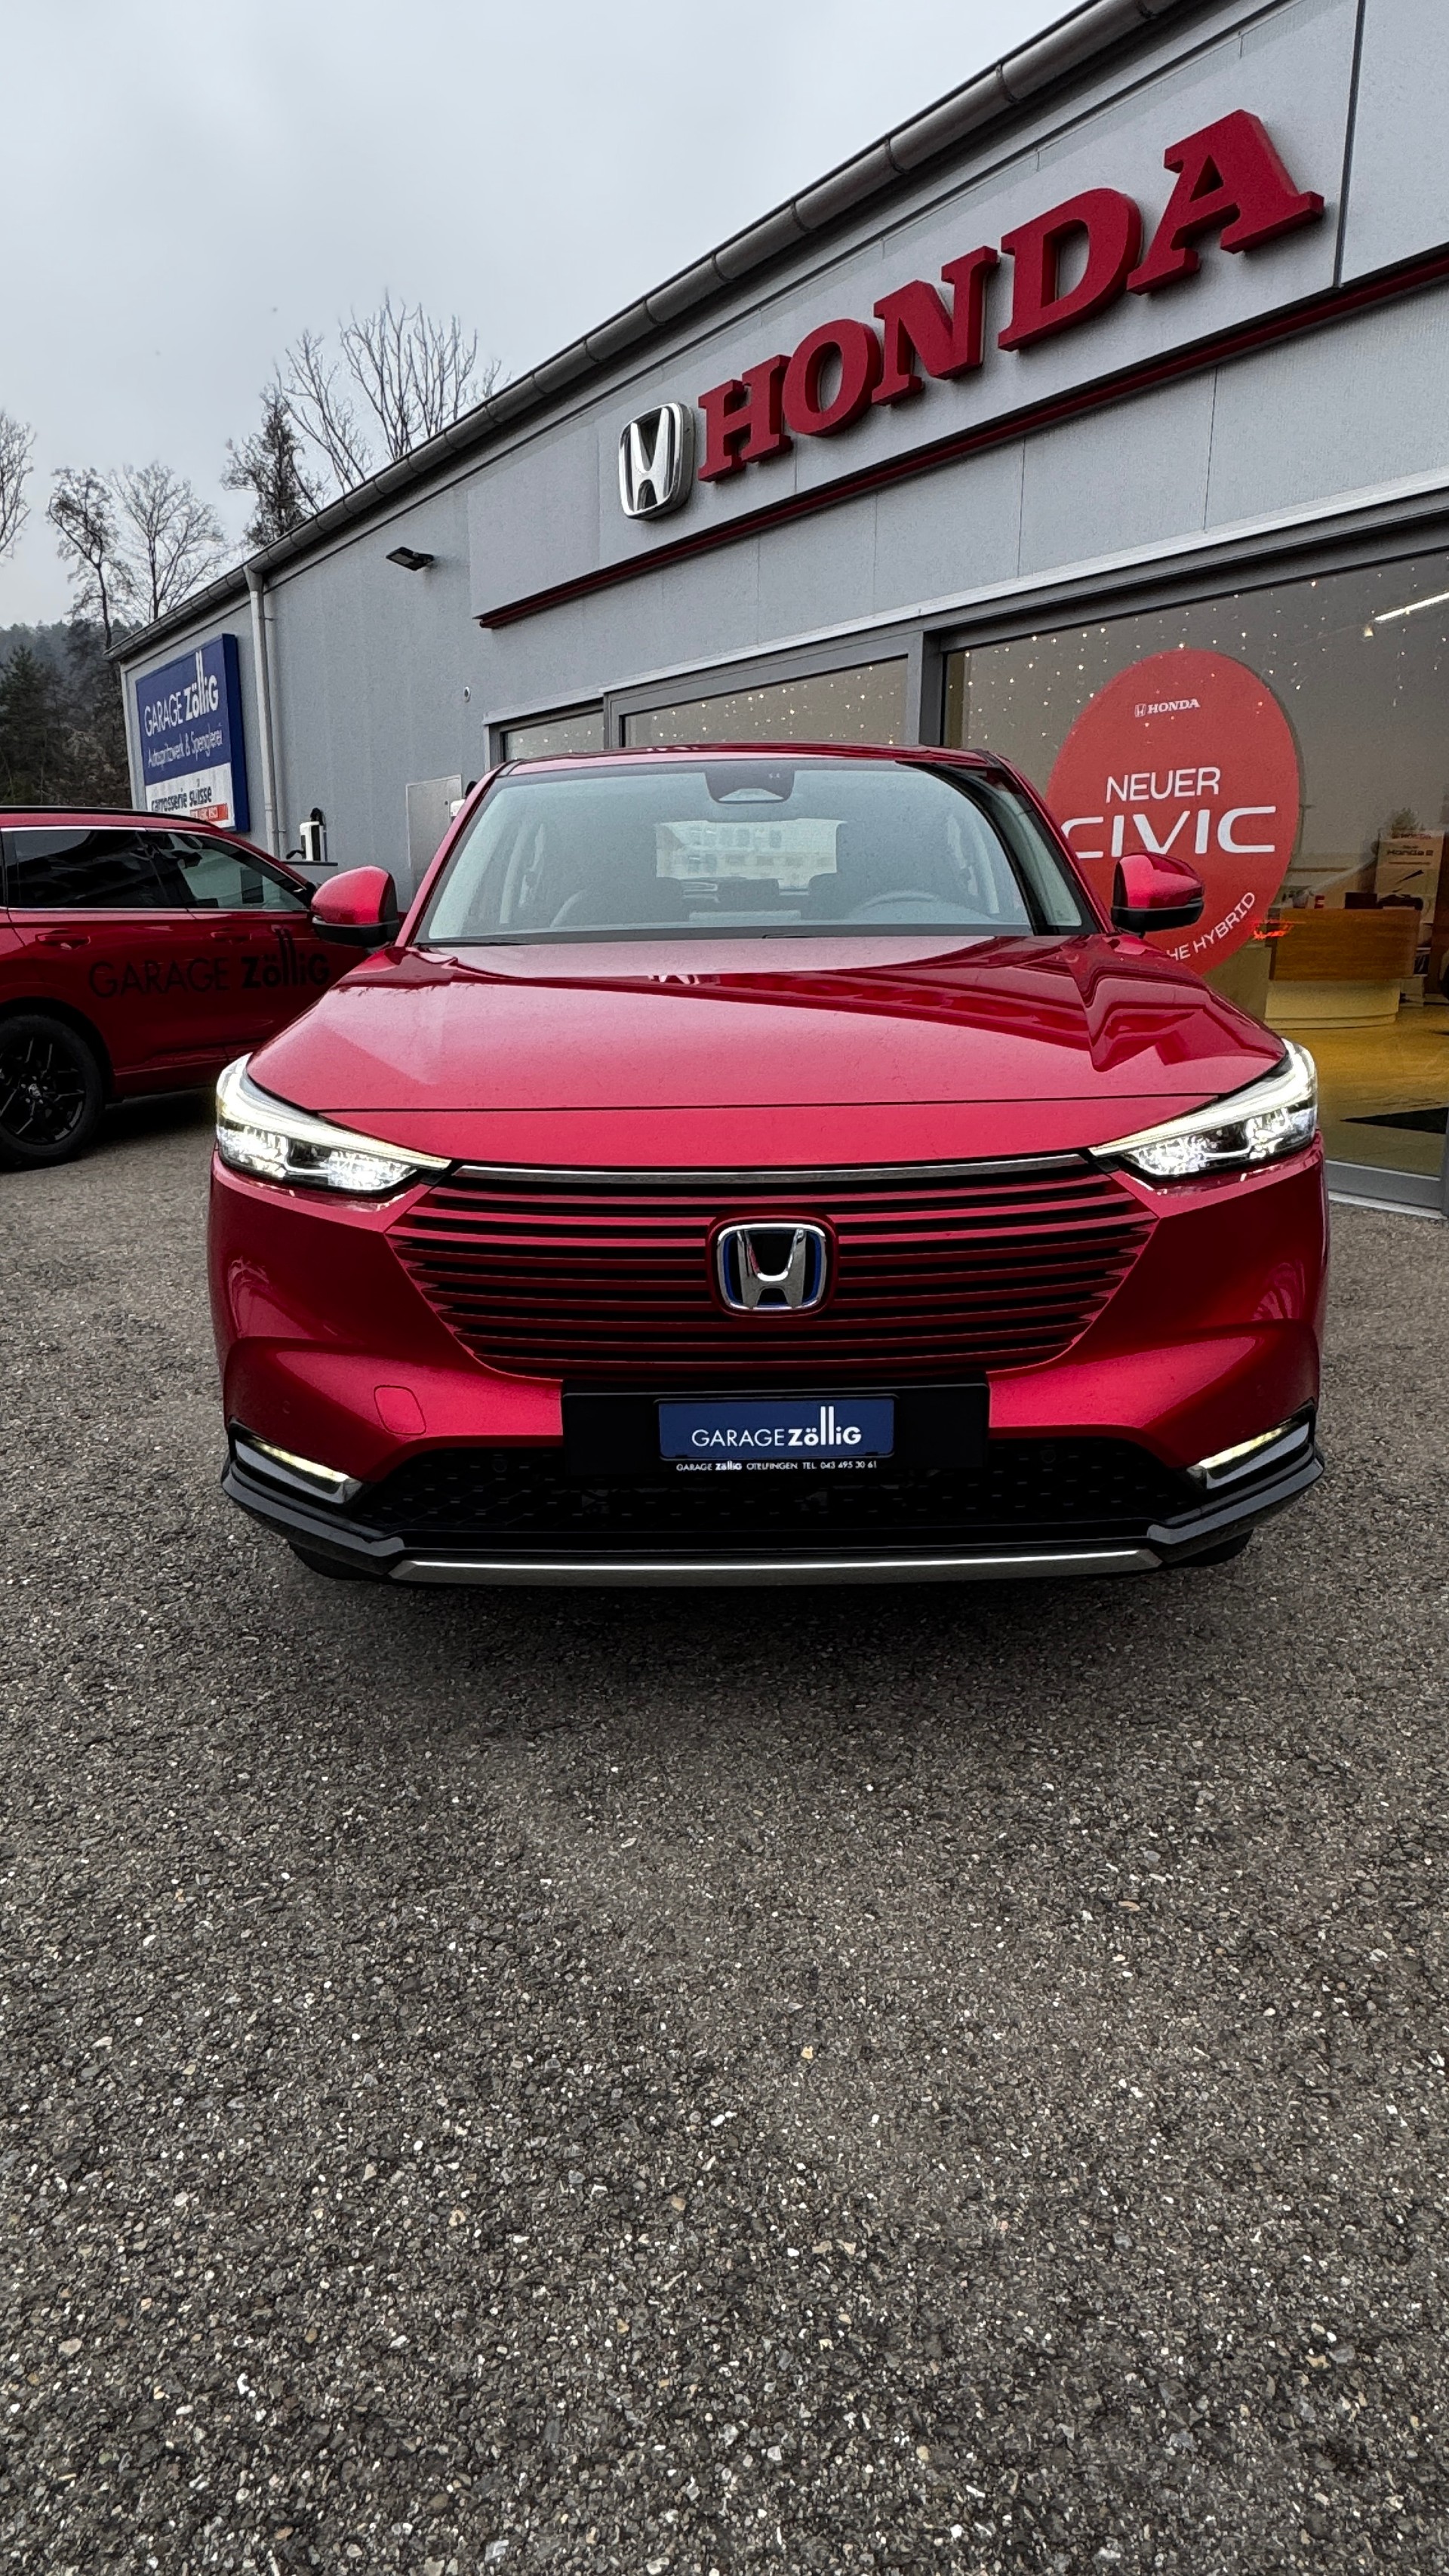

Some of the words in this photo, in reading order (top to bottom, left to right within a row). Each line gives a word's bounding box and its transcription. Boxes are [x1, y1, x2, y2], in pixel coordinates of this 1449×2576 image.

[698, 109, 1324, 482] HONDA
[144, 691, 183, 737] GARAGE
[1147, 698, 1201, 714] HONDA
[185, 732, 191, 756] &
[189, 778, 212, 807] suisse
[1106, 766, 1221, 804] NEUER
[1060, 805, 1277, 859] CIVIC
[1166, 943, 1191, 962] HE
[1192, 892, 1256, 953] HYBRID
[89, 956, 232, 999] GARAGE
[676, 1463, 712, 1471] GARAGE
[746, 1462, 798, 1471] OTELFINGEN
[820, 1461, 835, 1470] 043
[838, 1460, 854, 1470] 495
[868, 1460, 877, 1469] 61
